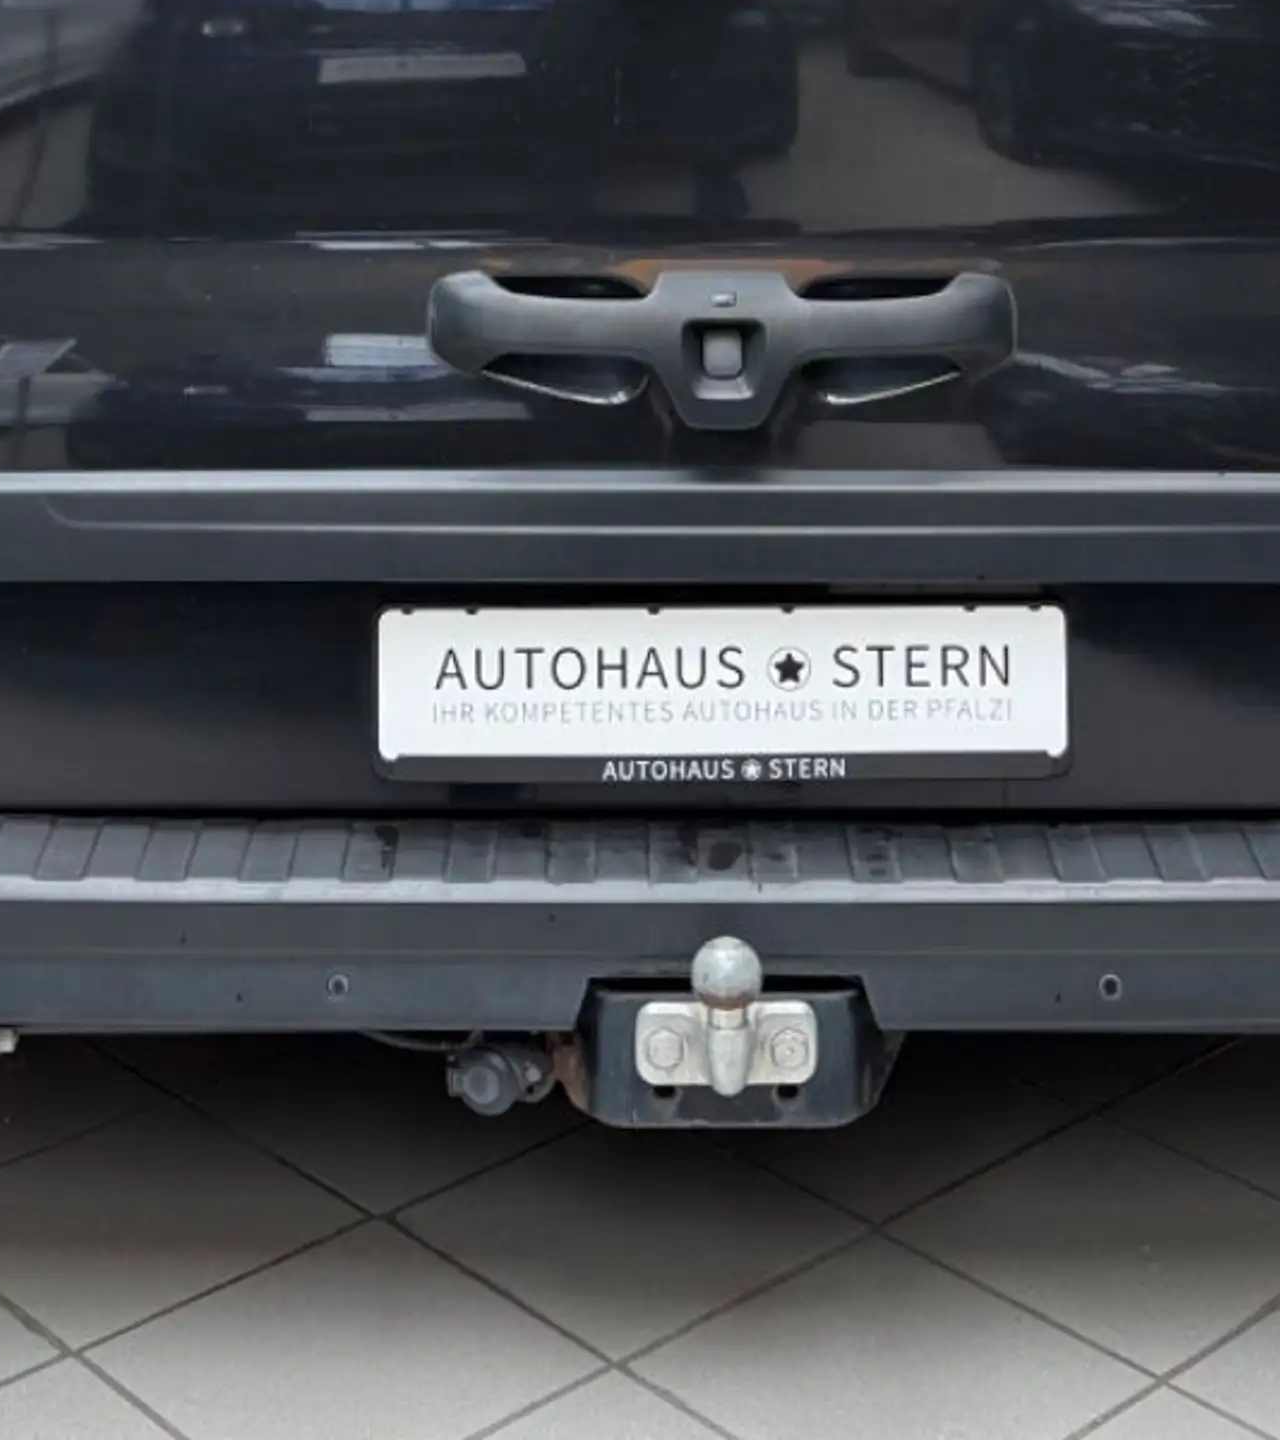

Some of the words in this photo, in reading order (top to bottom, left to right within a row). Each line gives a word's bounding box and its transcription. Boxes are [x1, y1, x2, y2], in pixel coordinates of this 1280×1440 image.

[434, 645, 746, 691] AUTOHAUS
[832, 643, 1010, 689] STERN
[432, 701, 475, 724] IHR
[485, 700, 674, 724] KOMPETENTES
[683, 699, 823, 723] AUTOHAUS
[831, 698, 858, 722] IN
[868, 698, 917, 721] DER
[602, 759, 735, 781] AUTOHAUS
[768, 757, 846, 779] STERN
